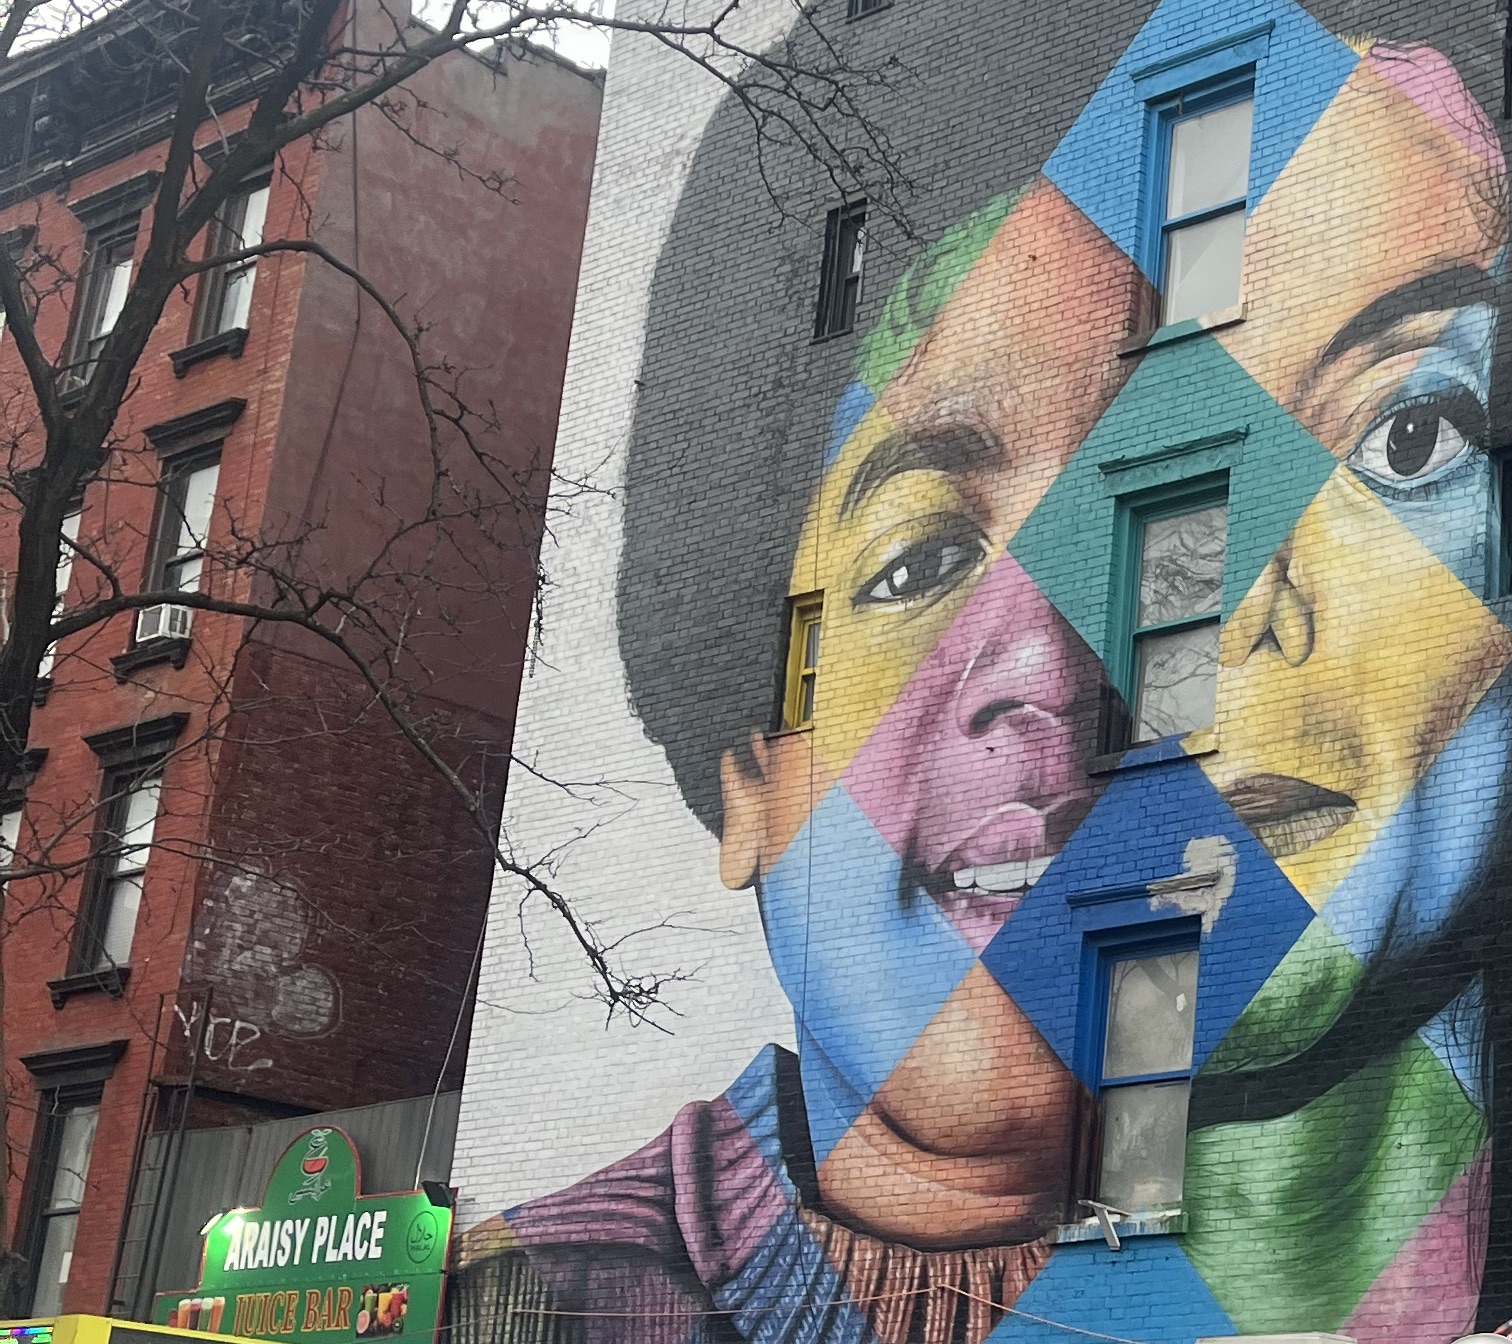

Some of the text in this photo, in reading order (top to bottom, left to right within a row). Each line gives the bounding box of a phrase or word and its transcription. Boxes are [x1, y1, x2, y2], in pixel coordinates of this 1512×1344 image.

[312, 1210, 388, 1263] PLACE
[232, 1287, 354, 1337] JUICE BAR
